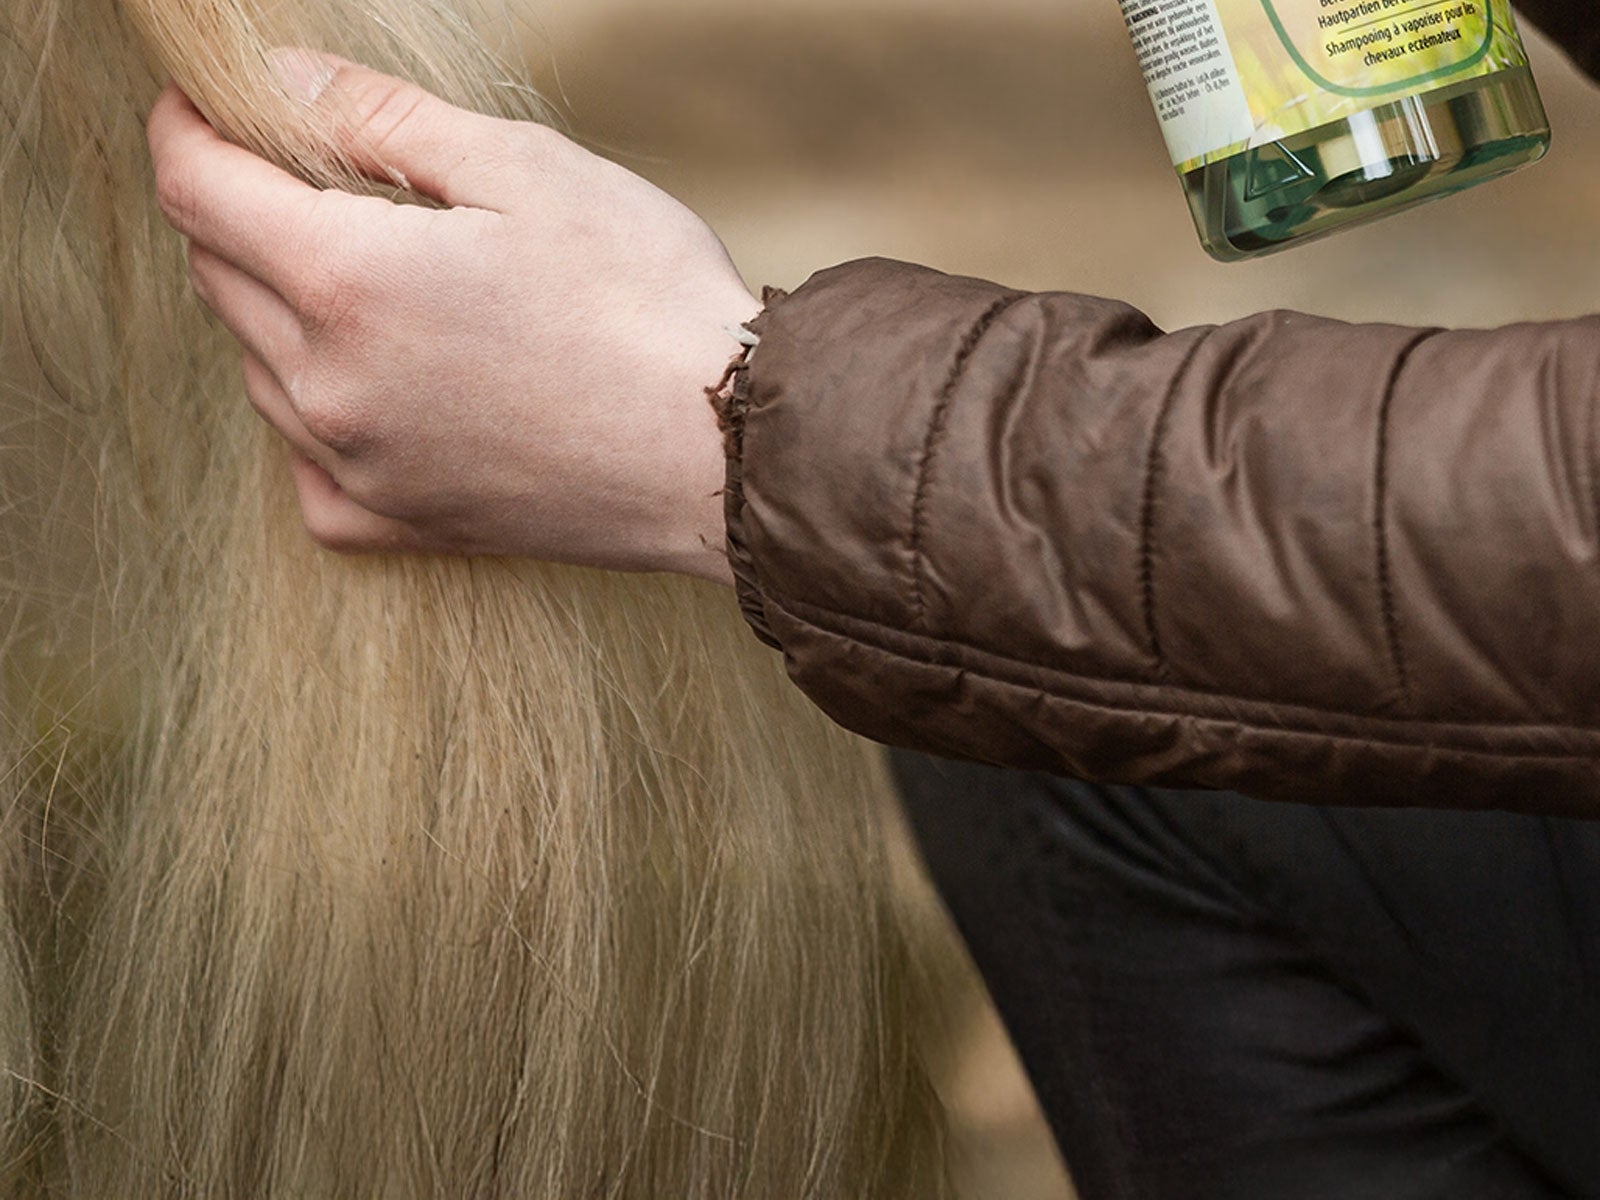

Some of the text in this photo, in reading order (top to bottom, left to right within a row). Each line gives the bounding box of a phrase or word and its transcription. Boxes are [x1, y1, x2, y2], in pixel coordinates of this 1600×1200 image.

[1317, 1, 1381, 28] Hautpartien
[1326, 2, 1476, 57] Shampooing à vaporiser pour les
[1364, 27, 1462, 67] chevaux eczémateux
